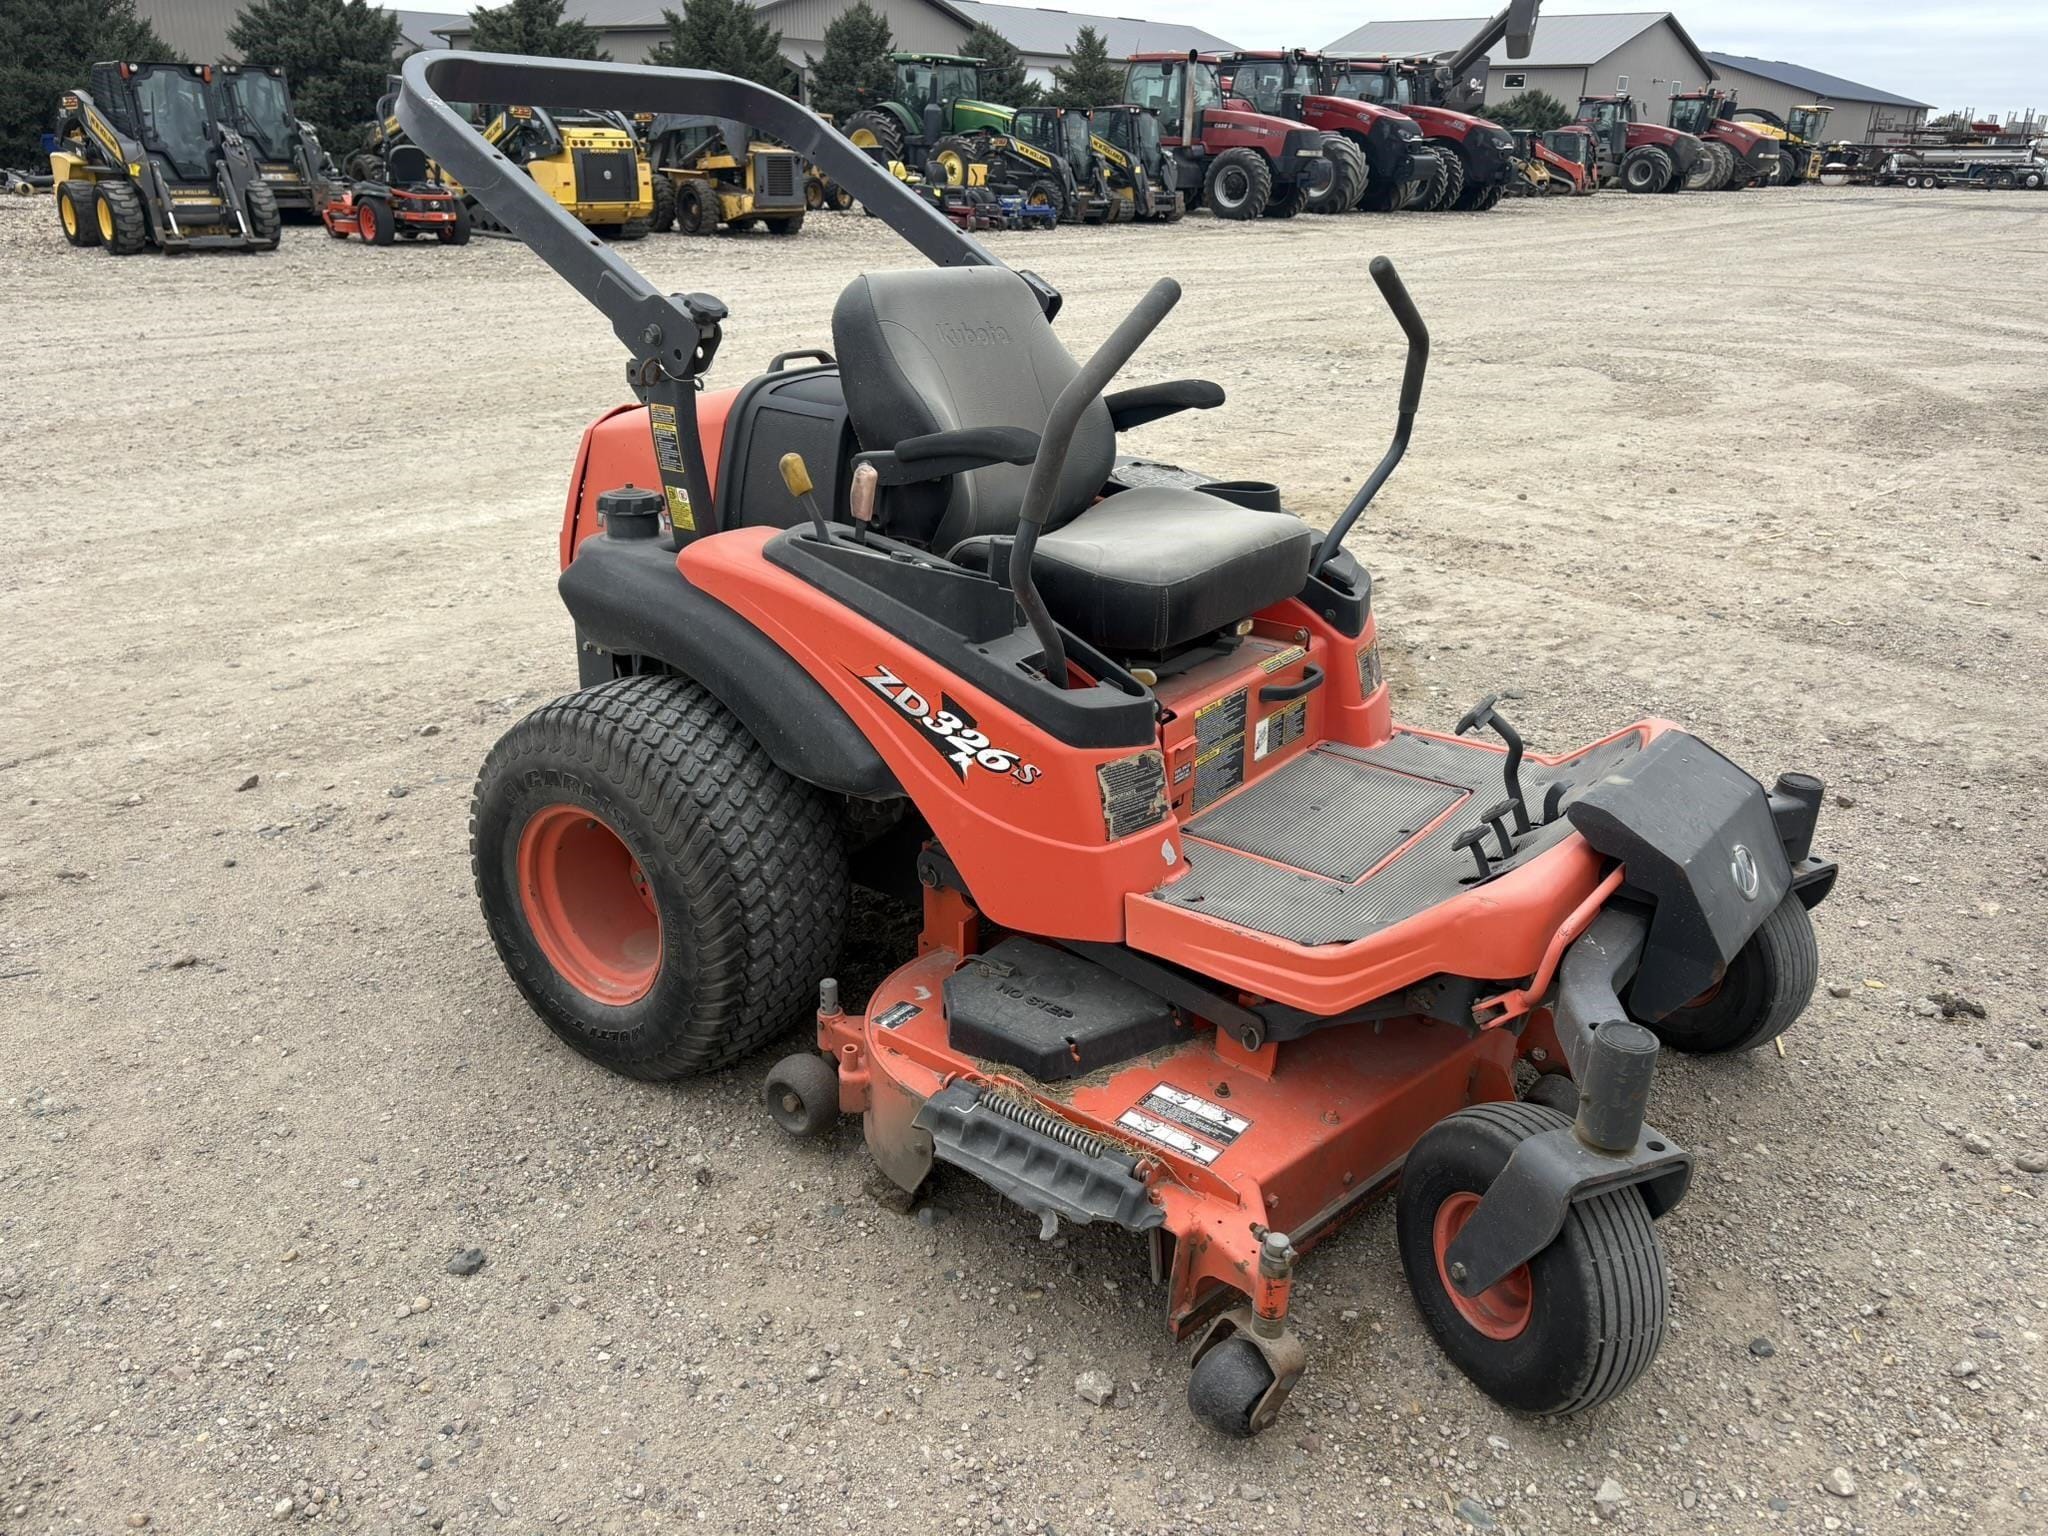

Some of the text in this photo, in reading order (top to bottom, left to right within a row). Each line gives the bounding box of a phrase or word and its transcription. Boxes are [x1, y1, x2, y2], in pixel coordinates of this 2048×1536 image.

[935, 321, 1014, 348] Kubota
[525, 769, 657, 873] CARLISLE
[995, 981, 1075, 1019] NO STEP
